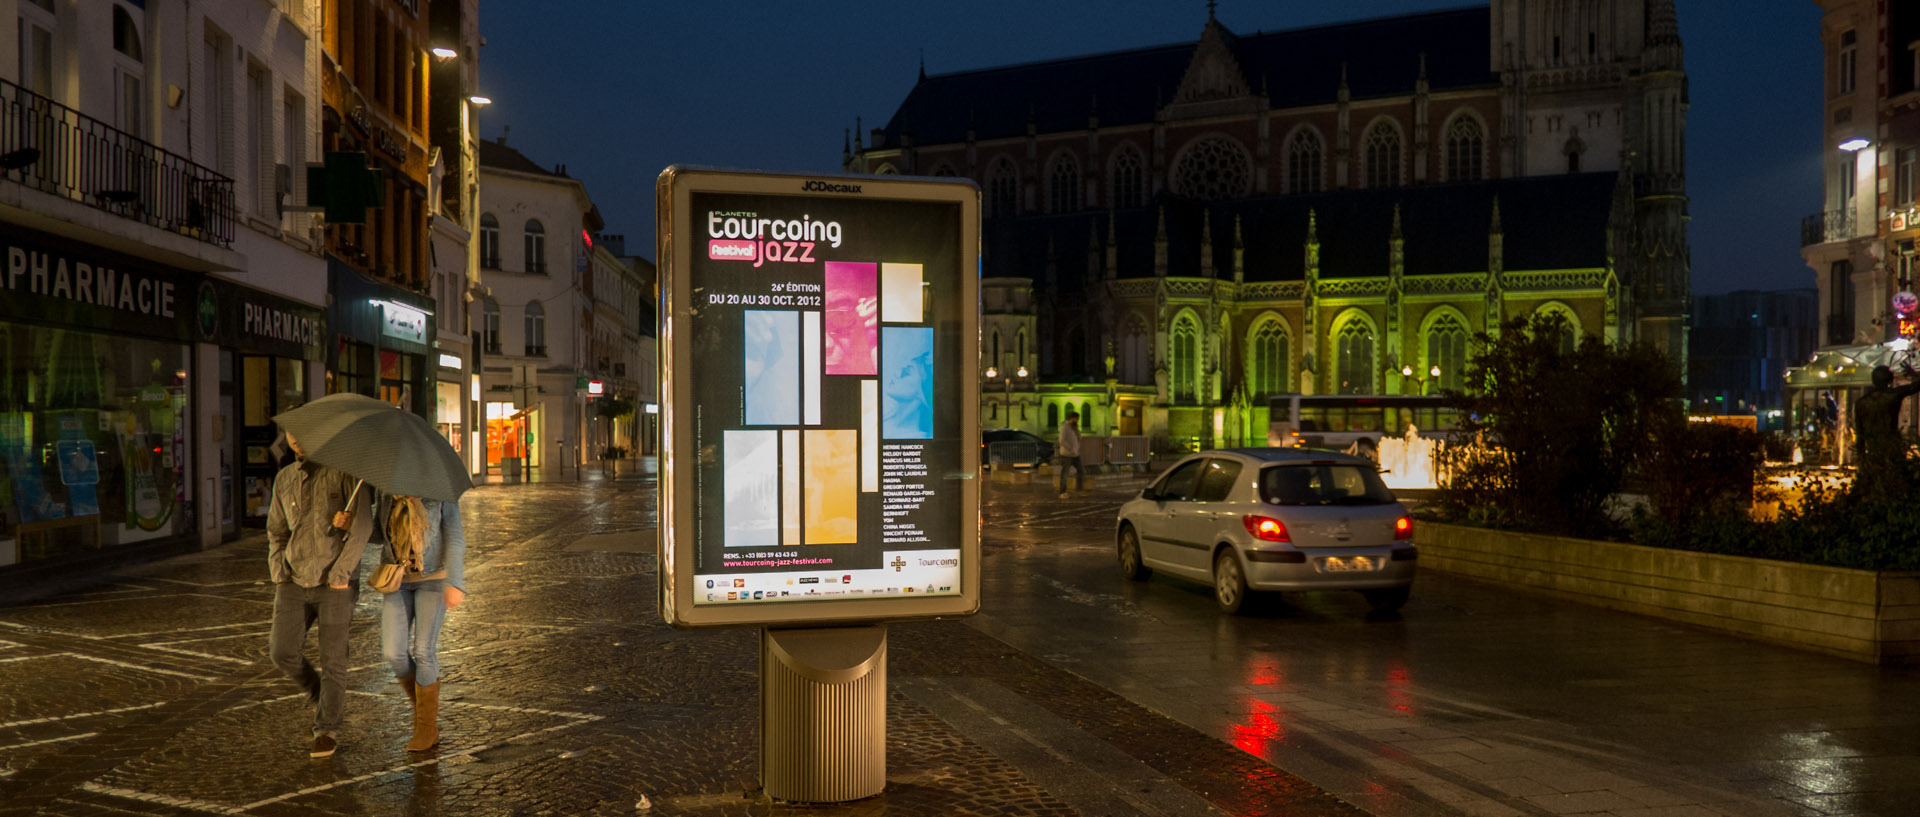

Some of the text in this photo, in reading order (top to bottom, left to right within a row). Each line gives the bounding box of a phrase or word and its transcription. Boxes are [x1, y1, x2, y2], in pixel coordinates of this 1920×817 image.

[801, 181, 862, 194] JCDecaux
[714, 210, 758, 218] PLANETES
[708, 210, 842, 248] tourcoing
[753, 235, 816, 268] jazz
[0, 246, 175, 319] PHARMACIE
[786, 281, 821, 292] ÉDITION
[709, 293, 821, 306] DU 20 AU 30 OCT. 2012
[244, 301, 320, 347] PHARMACIE
[723, 558, 833, 567] www.tourcoing-jazz-festival.com
[917, 558, 958, 567] Tourcoing
